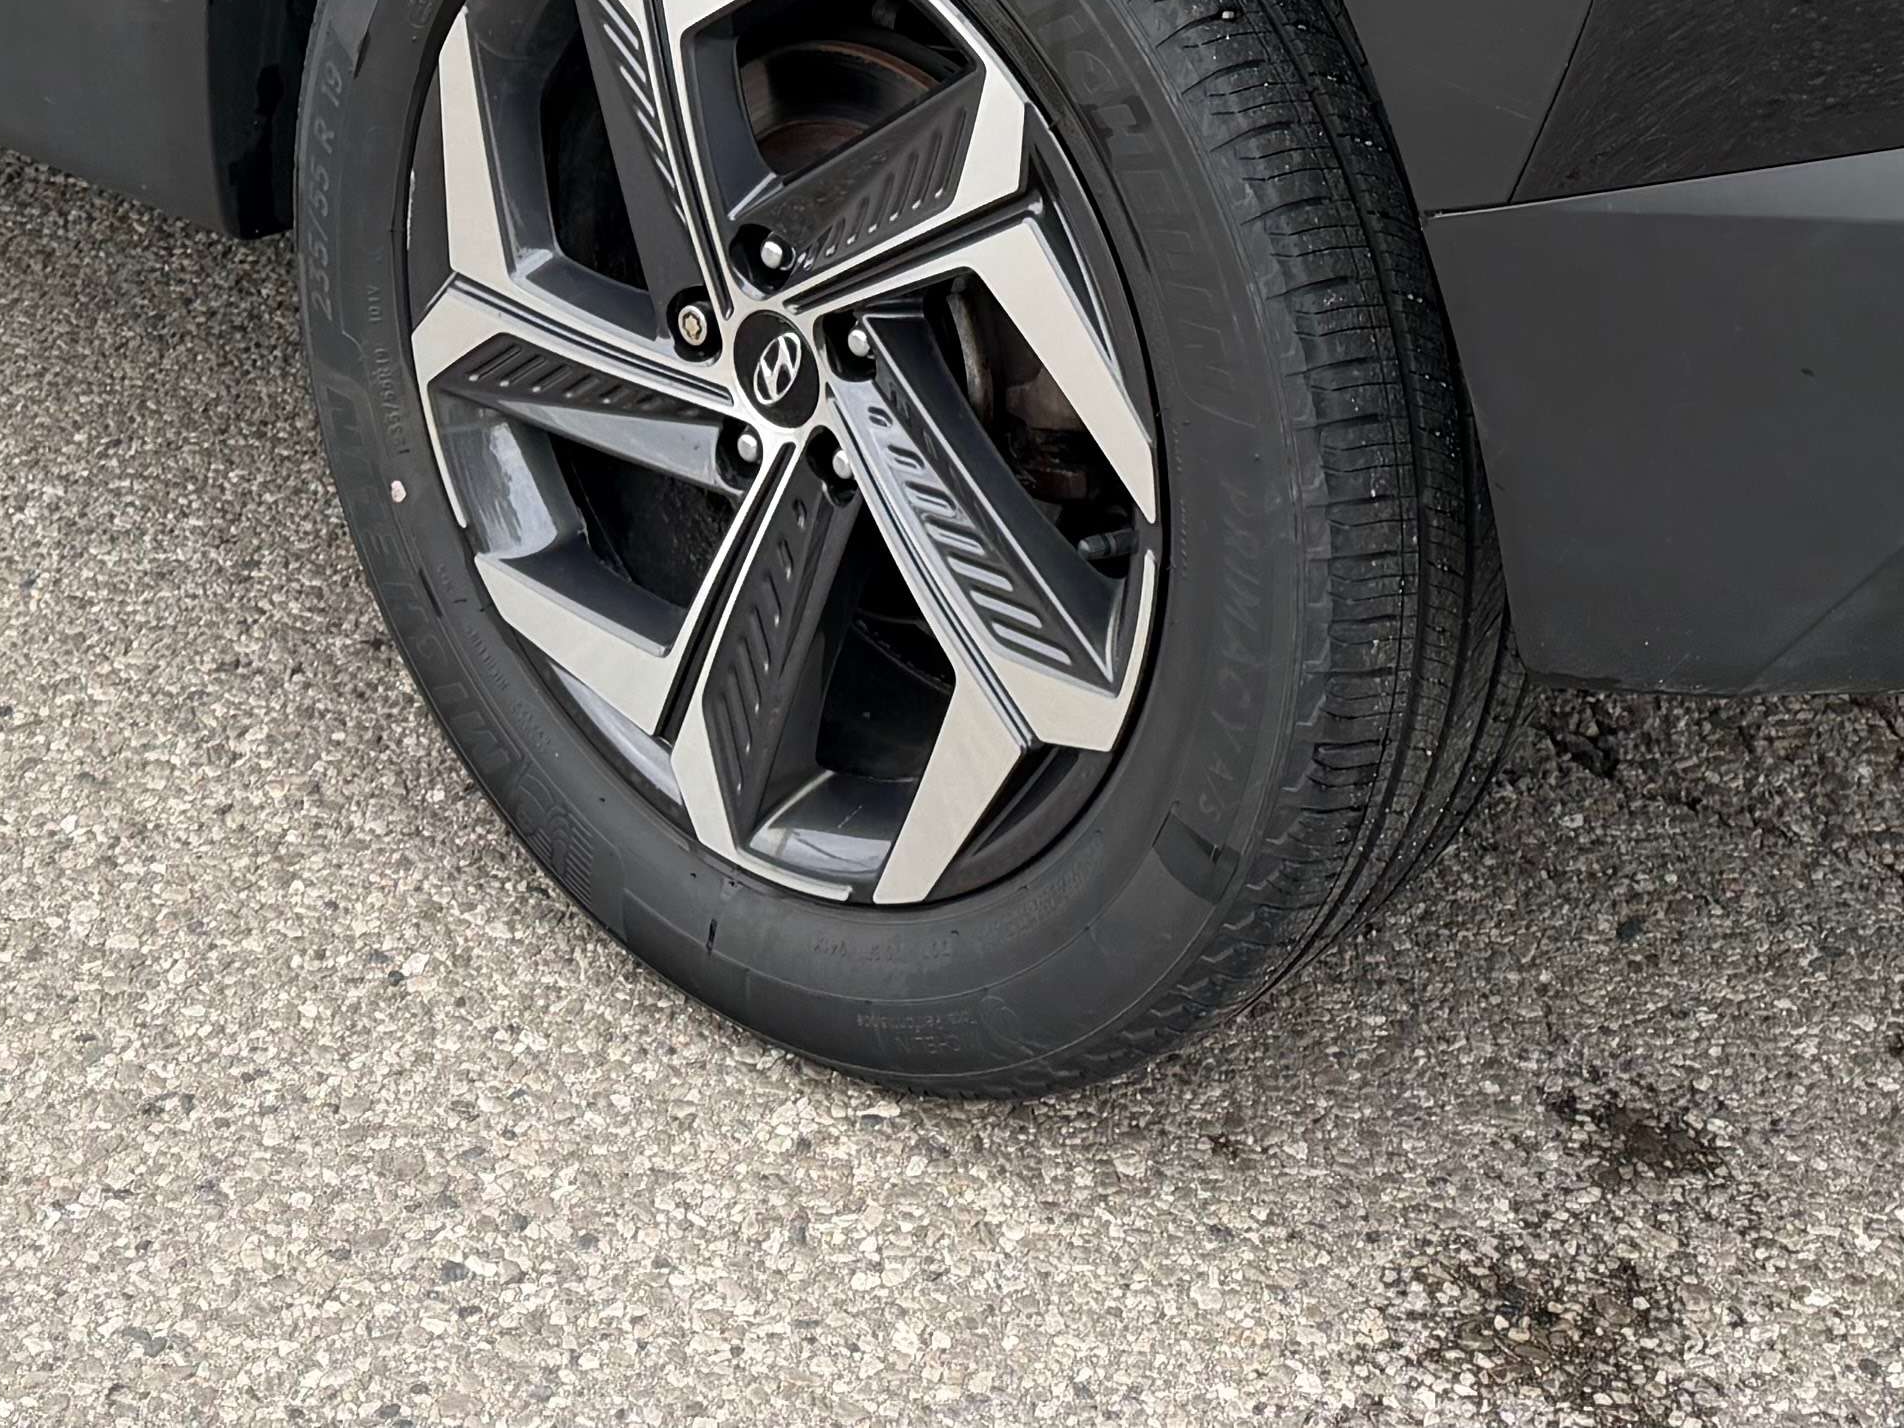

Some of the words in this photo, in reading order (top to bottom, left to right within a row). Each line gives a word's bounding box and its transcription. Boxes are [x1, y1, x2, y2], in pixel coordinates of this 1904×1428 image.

[321, 59, 344, 109] 19
[312, 116, 336, 155] R
[306, 155, 334, 322] 235/55
[1198, 752, 1237, 824] A/S
